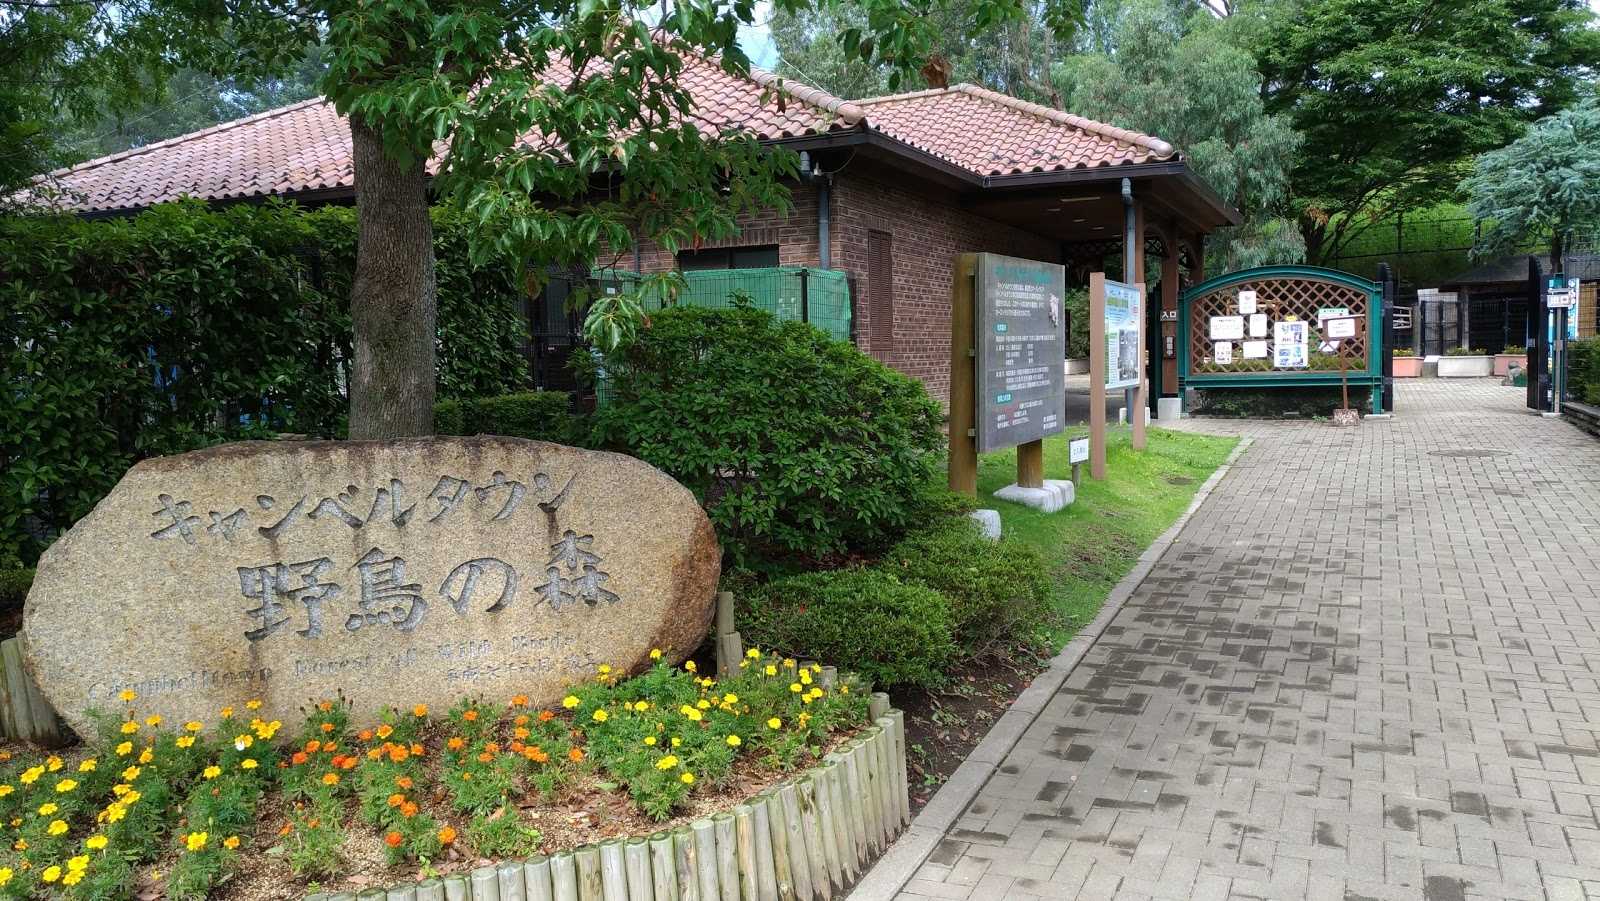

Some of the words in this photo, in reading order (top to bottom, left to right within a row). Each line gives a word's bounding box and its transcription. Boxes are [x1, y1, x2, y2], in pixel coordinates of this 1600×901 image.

[1161, 311, 1177, 319] 入口
[151, 471, 578, 545] キャンベルタウン
[237, 529, 620, 641] 野鳥の森
